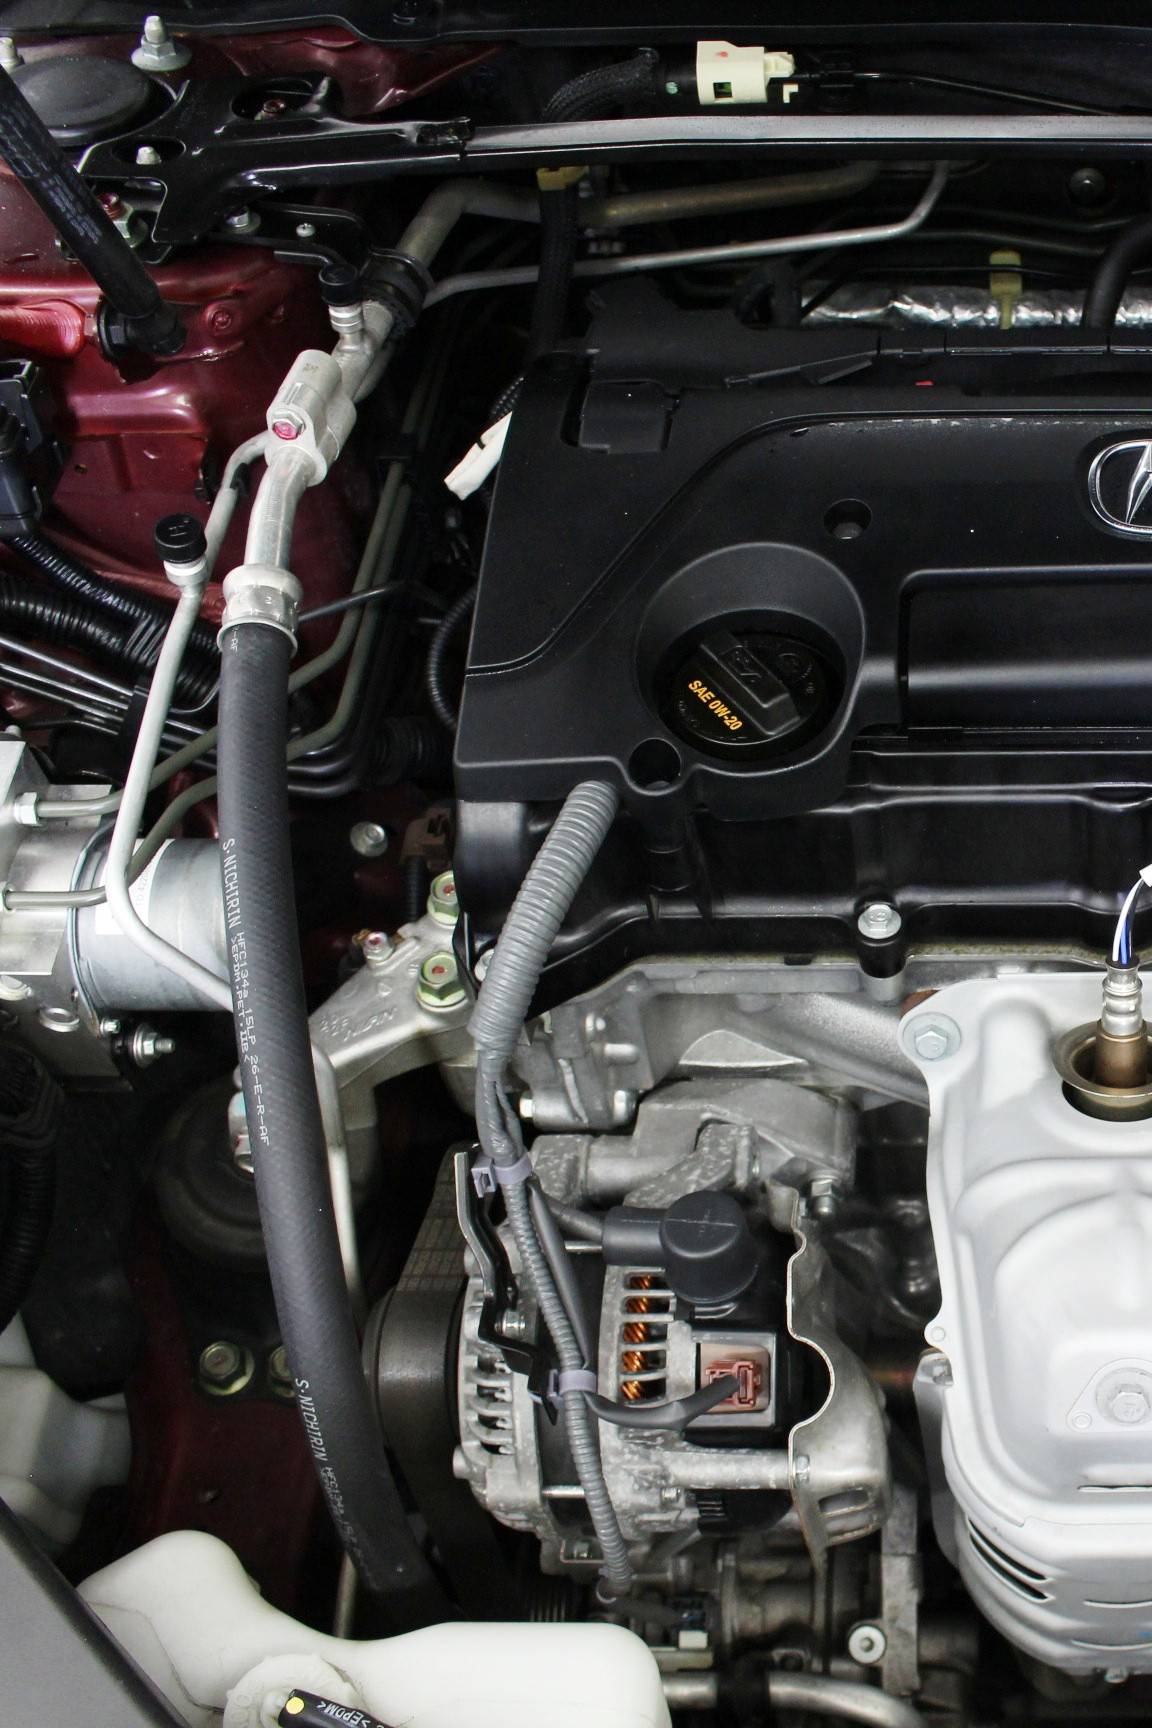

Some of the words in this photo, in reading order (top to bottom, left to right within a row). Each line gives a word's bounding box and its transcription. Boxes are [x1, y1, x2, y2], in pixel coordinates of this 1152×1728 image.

[688, 680, 716, 703] SAE
[708, 700, 743, 731] 0W-20
[236, 931, 250, 998] HFC134a
[244, 1007, 257, 1045] 15LP
[250, 1055, 270, 1147] 26-E-R-AF
